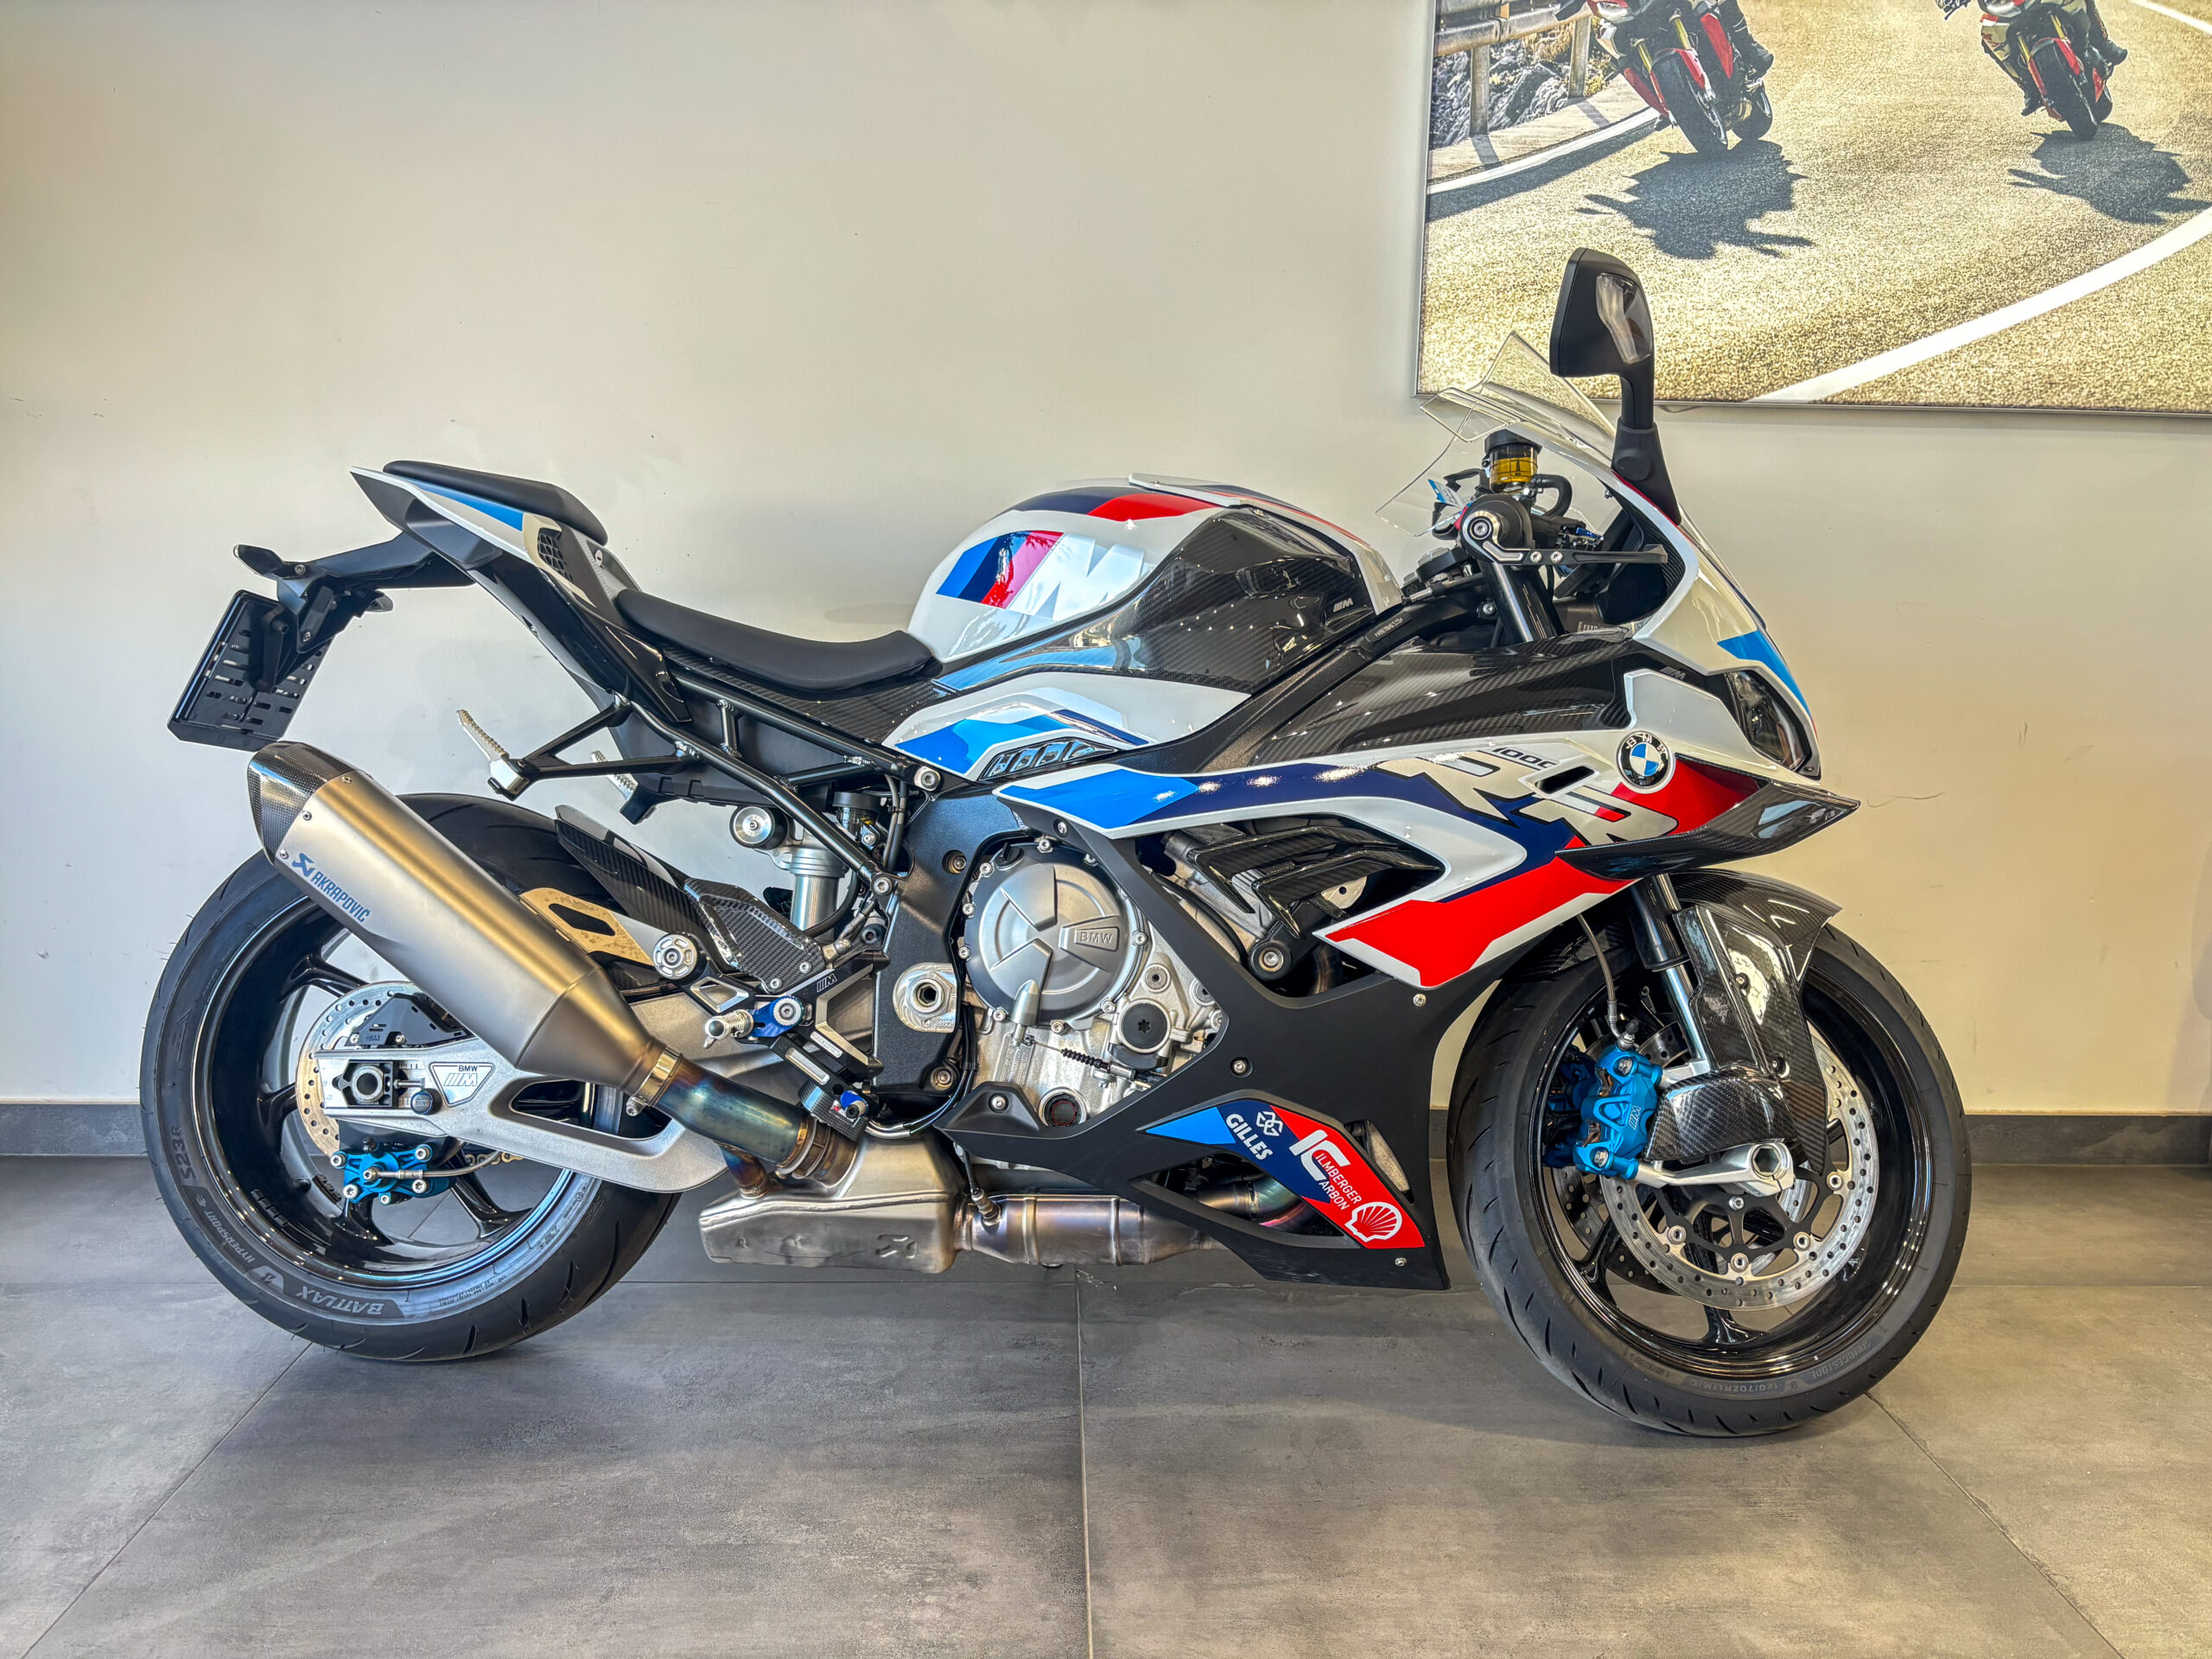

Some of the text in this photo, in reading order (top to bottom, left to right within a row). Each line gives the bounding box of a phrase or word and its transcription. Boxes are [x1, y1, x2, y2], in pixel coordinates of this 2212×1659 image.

[1626, 733, 1667, 754] BMW
[1080, 931, 1113, 944] BMW
[1226, 1113, 1273, 1161] GILLES
[1316, 1153, 1363, 1205] ILMBERGER
[204, 1209, 255, 1263] HYPERSPORT
[296, 1285, 383, 1315] BATTLAX
[1811, 1340, 1872, 1381] BRIDGESTONE
